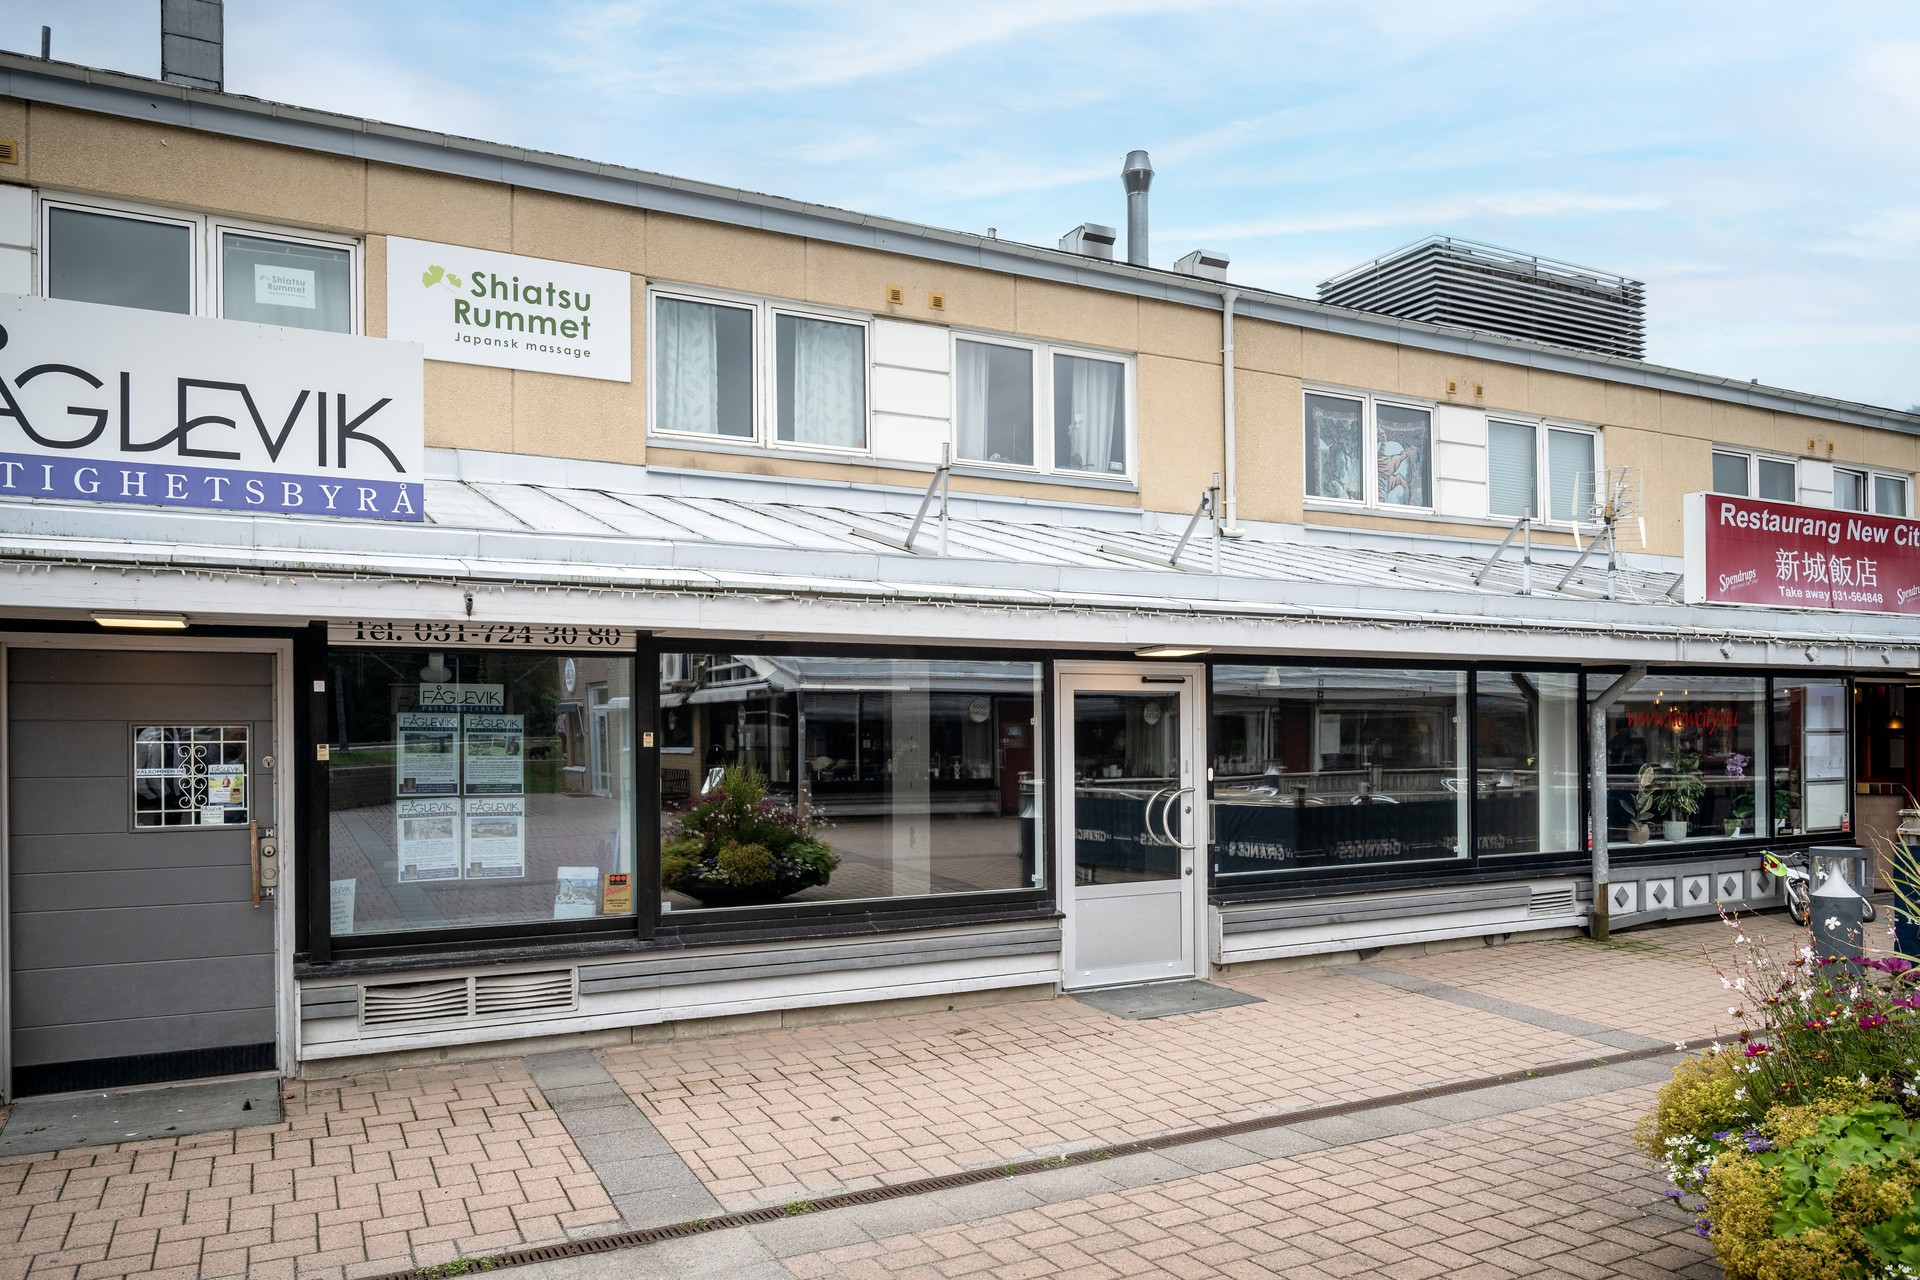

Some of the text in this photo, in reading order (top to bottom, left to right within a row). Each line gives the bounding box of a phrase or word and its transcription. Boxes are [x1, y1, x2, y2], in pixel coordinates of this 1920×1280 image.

[267, 283, 305, 294] Rummet
[271, 275, 306, 286] Shiatsu
[471, 270, 592, 312] Shiatsu
[454, 298, 592, 341] Rummet
[455, 331, 592, 359] Japansk massage
[0, 461, 416, 515] TIGHETSBYRÅ
[1720, 502, 1841, 544] Restaurang
[1846, 519, 1889, 544] New
[1775, 547, 1878, 588] 新城飯店
[1719, 569, 1757, 592] Spendrups
[1778, 586, 1884, 604] Take away 031-564848
[349, 620, 621, 646] Tel. 031-724 30 80
[422, 685, 502, 705] FÅGLEVIK
[402, 714, 455, 728] FÅGLEVIK
[470, 715, 520, 729] FÅGLEVIK
[1627, 705, 1739, 736] www.newcity.nu
[402, 800, 454, 814] FÅGLEVIK
[470, 800, 520, 813] FÅGLEVIK
